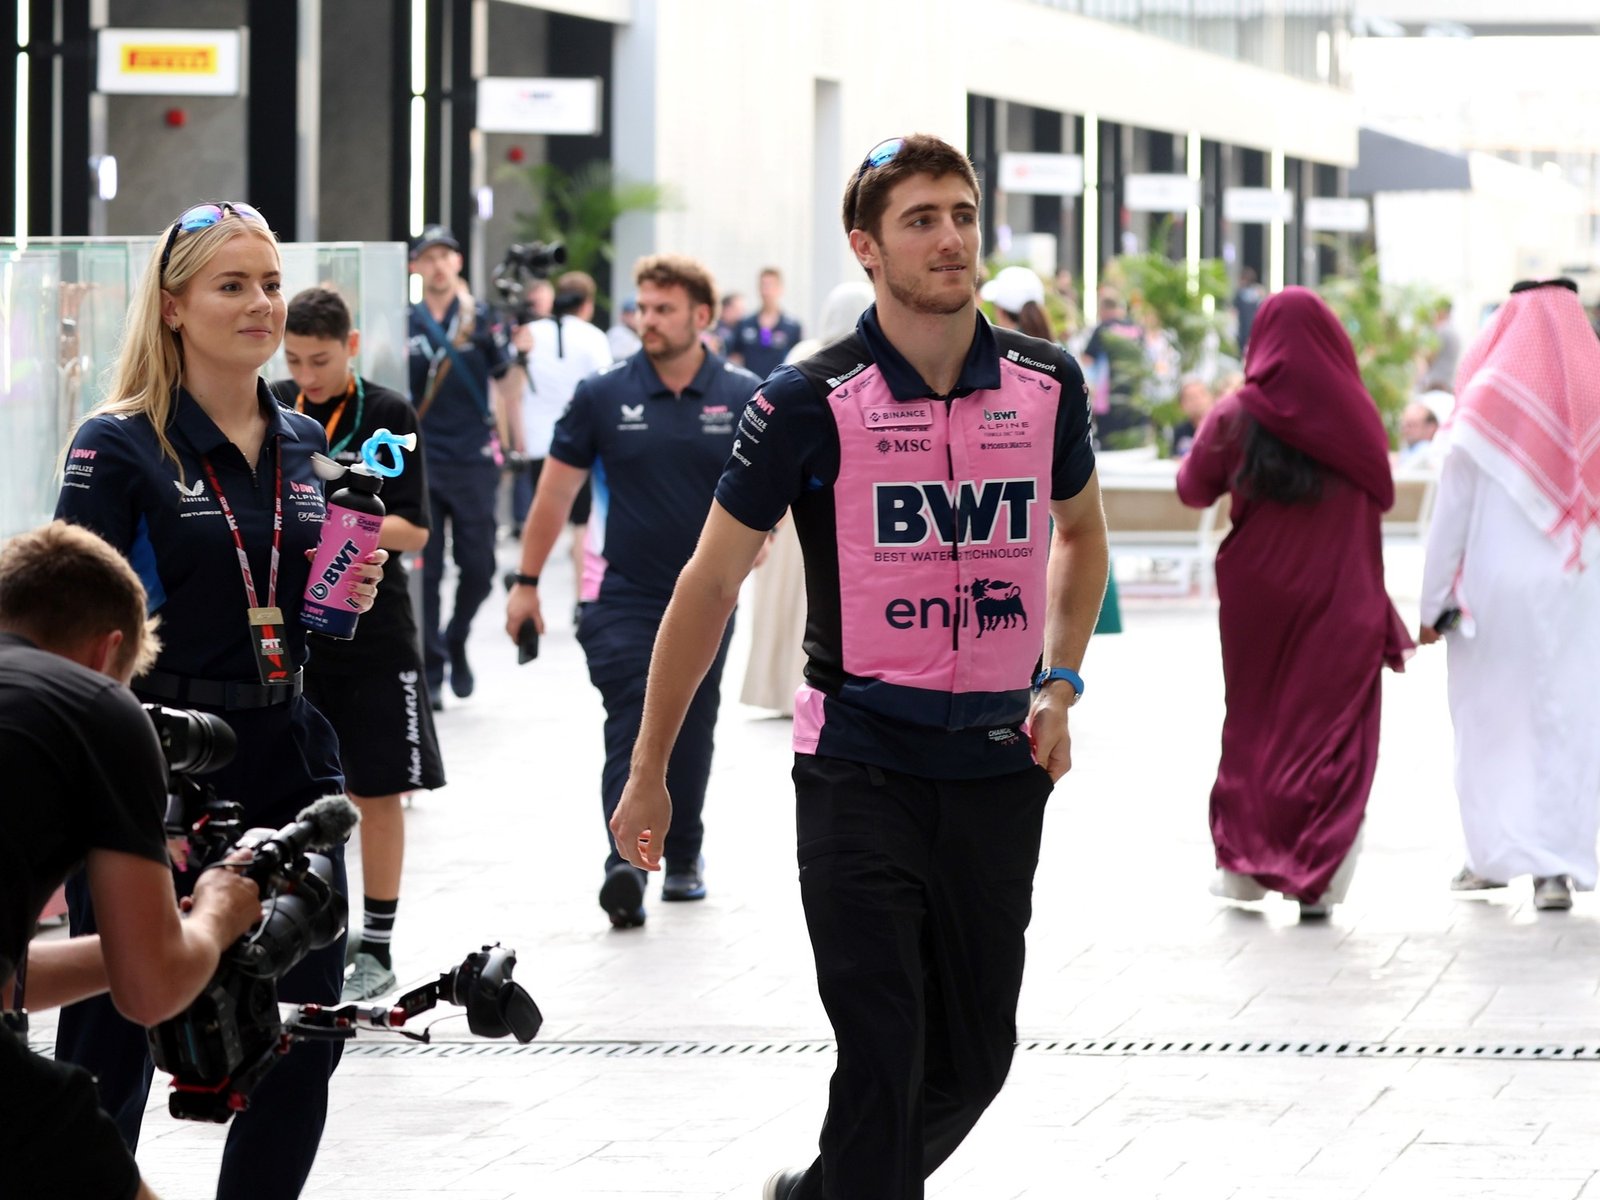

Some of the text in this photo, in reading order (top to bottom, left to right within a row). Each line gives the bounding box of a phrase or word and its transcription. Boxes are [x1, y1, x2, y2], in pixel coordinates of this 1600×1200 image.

[1019, 355, 1057, 373] Microsoft
[882, 410, 926, 420] BINANCE
[993, 410, 1017, 421] BWT
[978, 421, 1030, 430] ALPINE
[894, 438, 932, 453] MSC
[299, 483, 316, 494] BWT
[872, 477, 1037, 547] BWT
[874, 551, 907, 563] BEST
[321, 538, 361, 588] BWT
[261, 638, 281, 649] PIT
